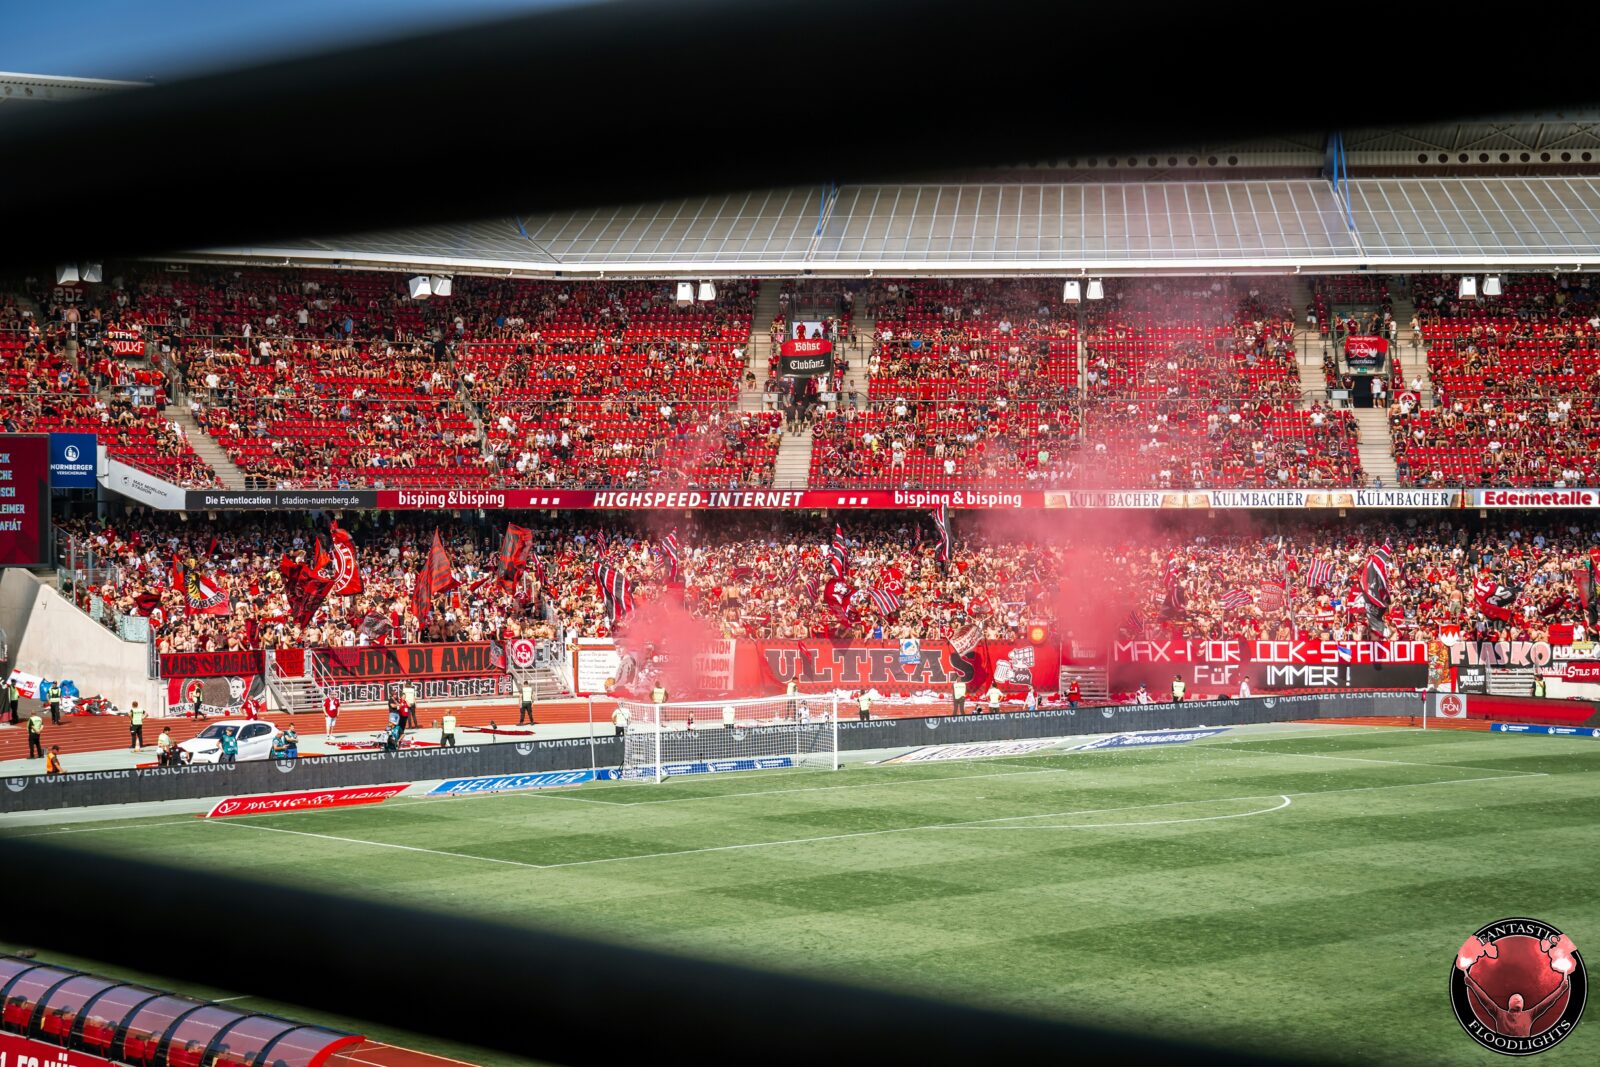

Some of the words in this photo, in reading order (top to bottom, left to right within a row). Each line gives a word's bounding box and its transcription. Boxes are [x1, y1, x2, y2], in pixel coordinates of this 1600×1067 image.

[50, 463, 93, 471] NÜRNBERGER
[205, 496, 219, 505] Die
[220, 496, 271, 505] Eventlocation
[282, 495, 359, 506] stadion-nuernberg.de
[399, 491, 446, 508] bisping
[459, 491, 505, 508] bisping
[593, 491, 804, 507] HIGHSPEED-INTERNET
[894, 491, 950, 508] bisping
[967, 491, 1022, 508] bisping
[1069, 490, 1160, 507] KULMBACHER
[1212, 490, 1304, 507] KULMBACHER
[1357, 490, 1449, 506] KULMBACHER
[408, 648, 434, 675] DI
[441, 646, 498, 673] AMIC
[1450, 640, 1552, 666] FIASKO
[764, 647, 976, 684] ULTRAS
[1266, 665, 1338, 686] IMMER
